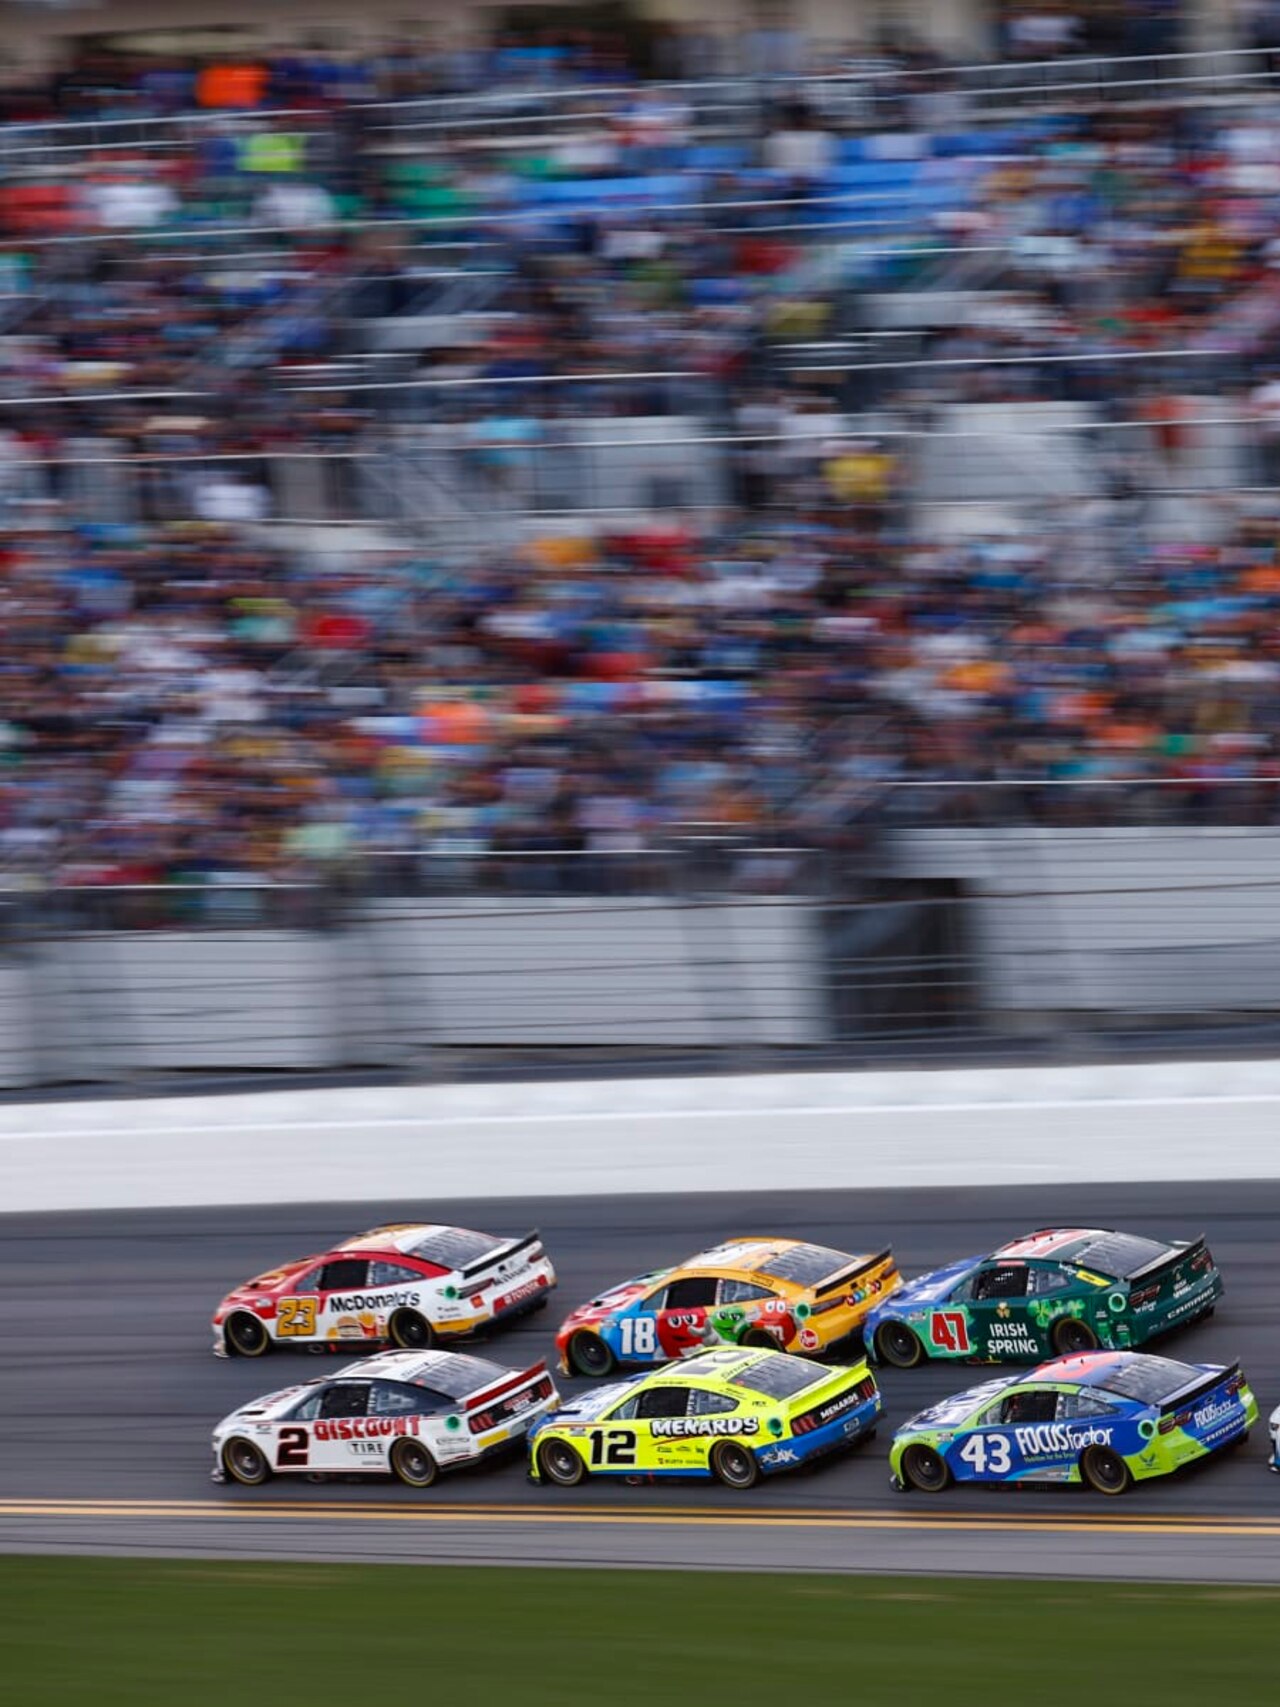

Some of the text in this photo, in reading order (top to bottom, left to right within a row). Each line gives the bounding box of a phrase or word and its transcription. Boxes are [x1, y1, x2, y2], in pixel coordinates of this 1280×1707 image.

[331, 1291, 421, 1312] McDonald's
[276, 1296, 318, 1337] 23
[988, 1322, 1029, 1338] IRISH
[620, 1317, 655, 1355] 18
[930, 1312, 970, 1353] 47
[986, 1338, 1040, 1354] SPRING
[314, 1416, 421, 1440] DISCOUNT
[650, 1416, 760, 1437] MENARDS
[277, 1427, 309, 1466] 2
[351, 1443, 385, 1454] TIRE
[587, 1430, 635, 1465] 12
[960, 1434, 1012, 1474] 43
